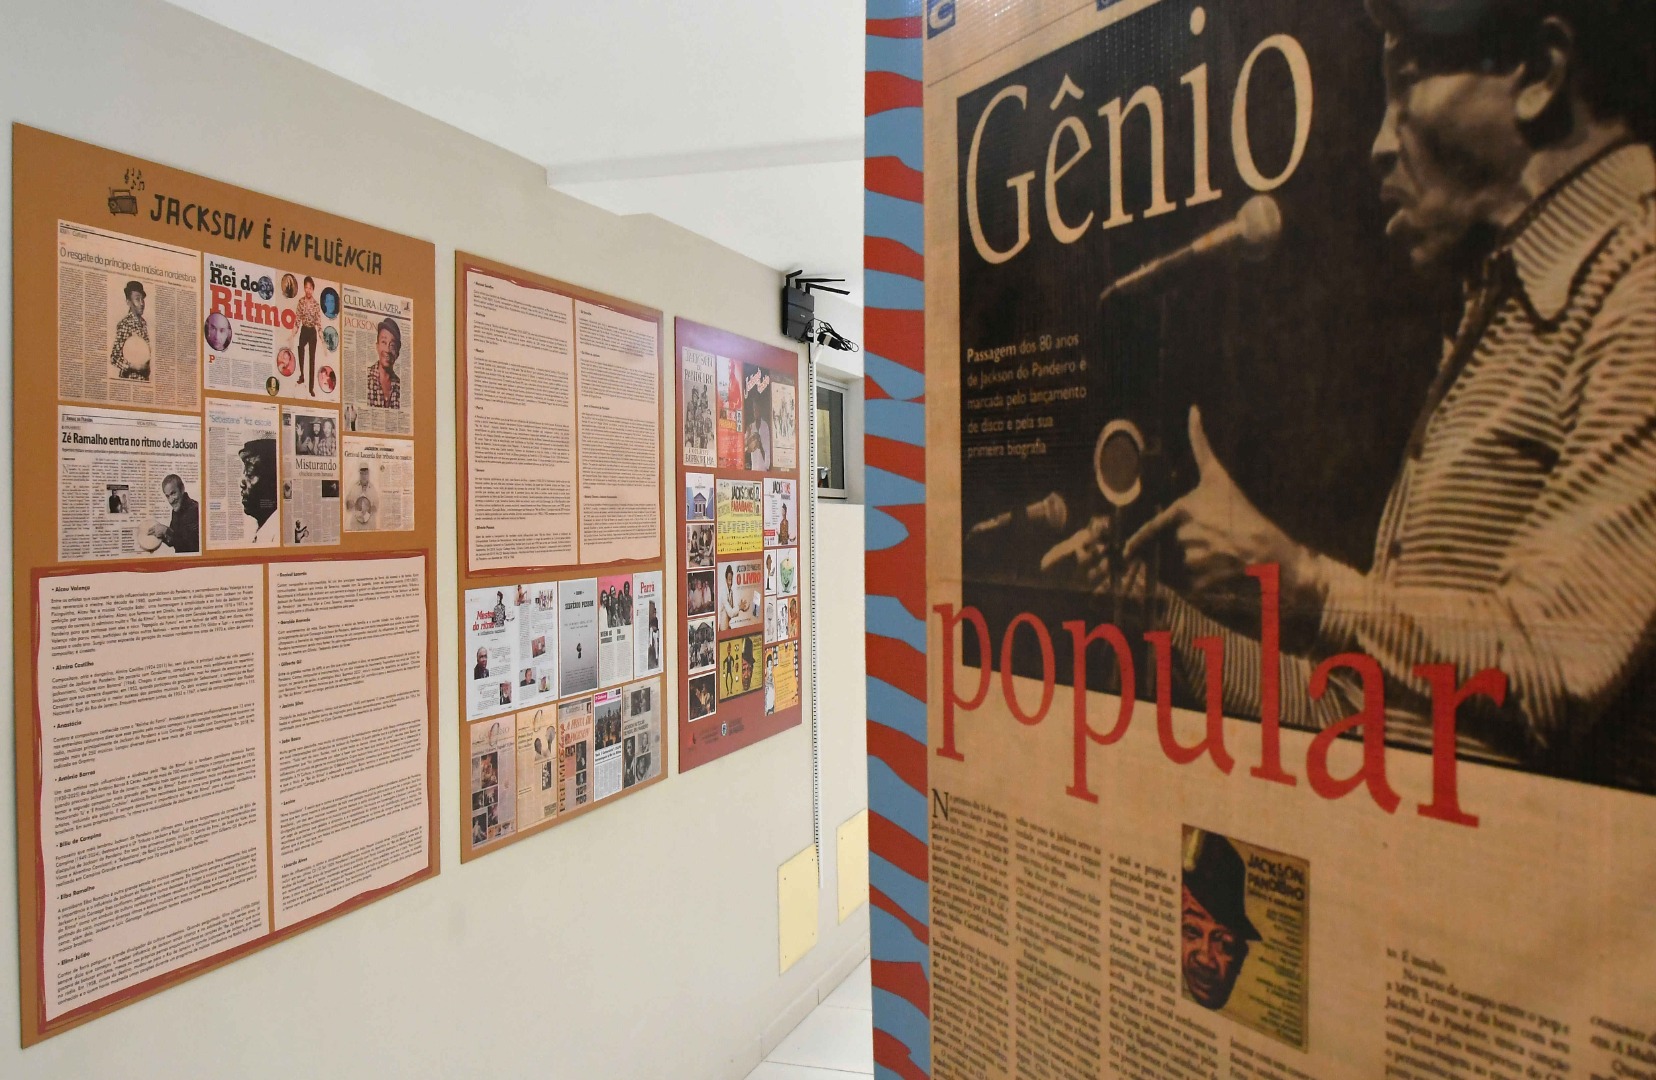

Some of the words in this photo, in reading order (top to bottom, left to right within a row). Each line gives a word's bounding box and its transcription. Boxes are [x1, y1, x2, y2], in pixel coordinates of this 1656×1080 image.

[966, 6, 1314, 264] Gênio
[150, 193, 254, 241] JACKSON
[263, 217, 272, 249] É
[60, 247, 66, 257] O
[67, 250, 94, 262] resgate
[94, 254, 104, 264] do
[104, 256, 131, 270] príncipe
[132, 261, 140, 272] da
[141, 264, 164, 276] música
[164, 270, 197, 282] nordestina
[210, 267, 237, 288] Rei
[241, 274, 260, 292] do
[210, 284, 296, 329] Ritmo
[344, 294, 376, 309] CULTURA
[380, 302, 399, 314] LAZER
[344, 317, 378, 331] JACKSON
[967, 344, 1017, 363] Passagem
[1020, 340, 1037, 354] dos
[1056, 334, 1079, 348] anos
[967, 375, 978, 387] de
[980, 369, 1014, 389] Jackson
[1016, 366, 1029, 380] do
[1032, 360, 1076, 377] Pandeiro
[1080, 359, 1087, 371] e
[968, 396, 1004, 409] marcada
[1007, 391, 1026, 409] pelo
[1030, 386, 1087, 404] lançamento
[968, 421, 978, 434] de
[981, 418, 1004, 432] disco
[1007, 420, 1012, 431] e
[1016, 416, 1034, 433] pela
[1038, 416, 1054, 428] sua
[62, 432, 72, 443] Zé
[73, 433, 108, 445] Ramalho
[109, 436, 130, 446] entra
[130, 438, 140, 447] no
[141, 436, 161, 448] ritmo
[162, 438, 171, 448] de
[172, 438, 198, 450] Jackson
[968, 443, 1004, 459] primeira
[1007, 438, 1046, 459] biografia
[295, 458, 337, 471] Misturando
[933, 562, 1507, 828] popular
[58, 772, 78, 781] Antônio
[932, 788, 949, 821] N
[80, 833, 102, 842] Campina
[60, 892, 72, 900] Elba
[73, 885, 95, 895] Ramalho
